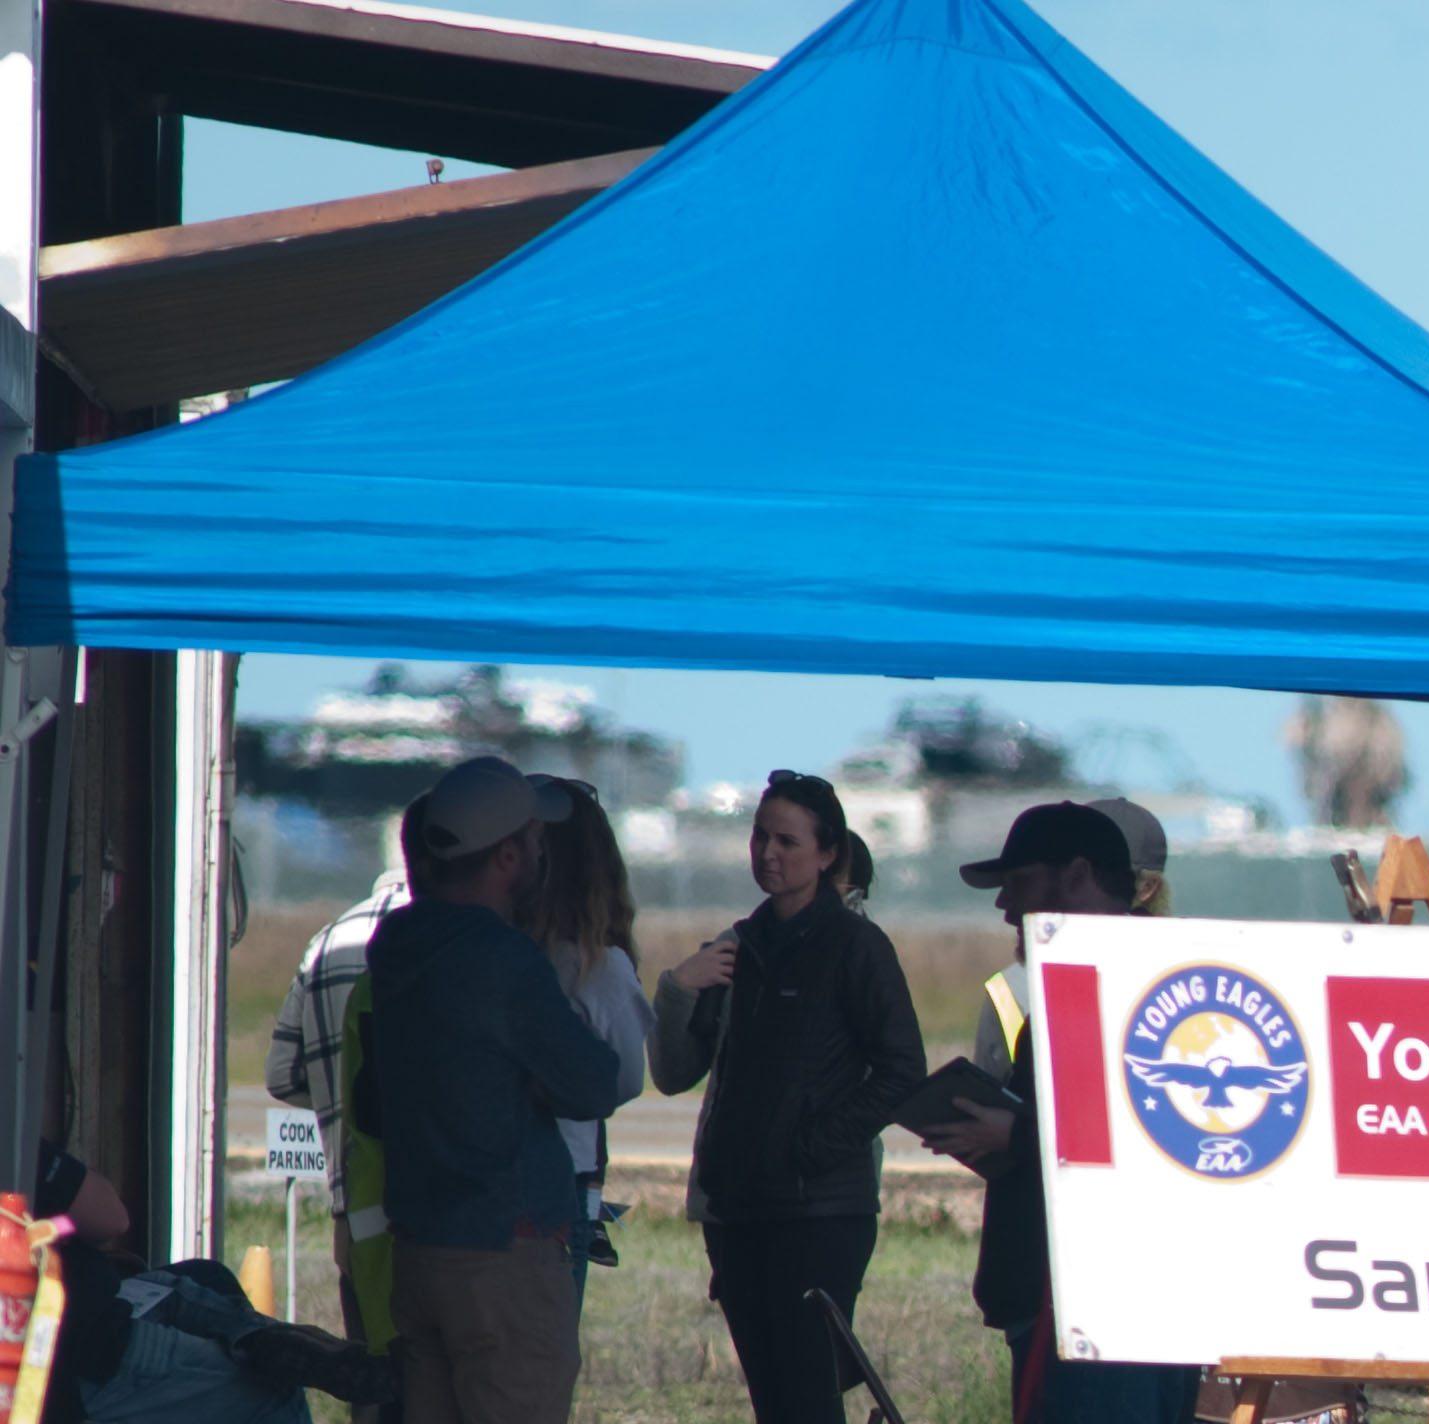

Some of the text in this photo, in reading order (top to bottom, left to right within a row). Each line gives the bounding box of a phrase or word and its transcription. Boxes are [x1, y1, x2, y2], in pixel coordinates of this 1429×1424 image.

[1135, 976, 1291, 1048] YOUNG EAGLES
[1357, 1103, 1428, 1137] EAA
[280, 1123, 315, 1143] COOK
[269, 1150, 325, 1171] PARKING
[1195, 1153, 1242, 1172] EAA
